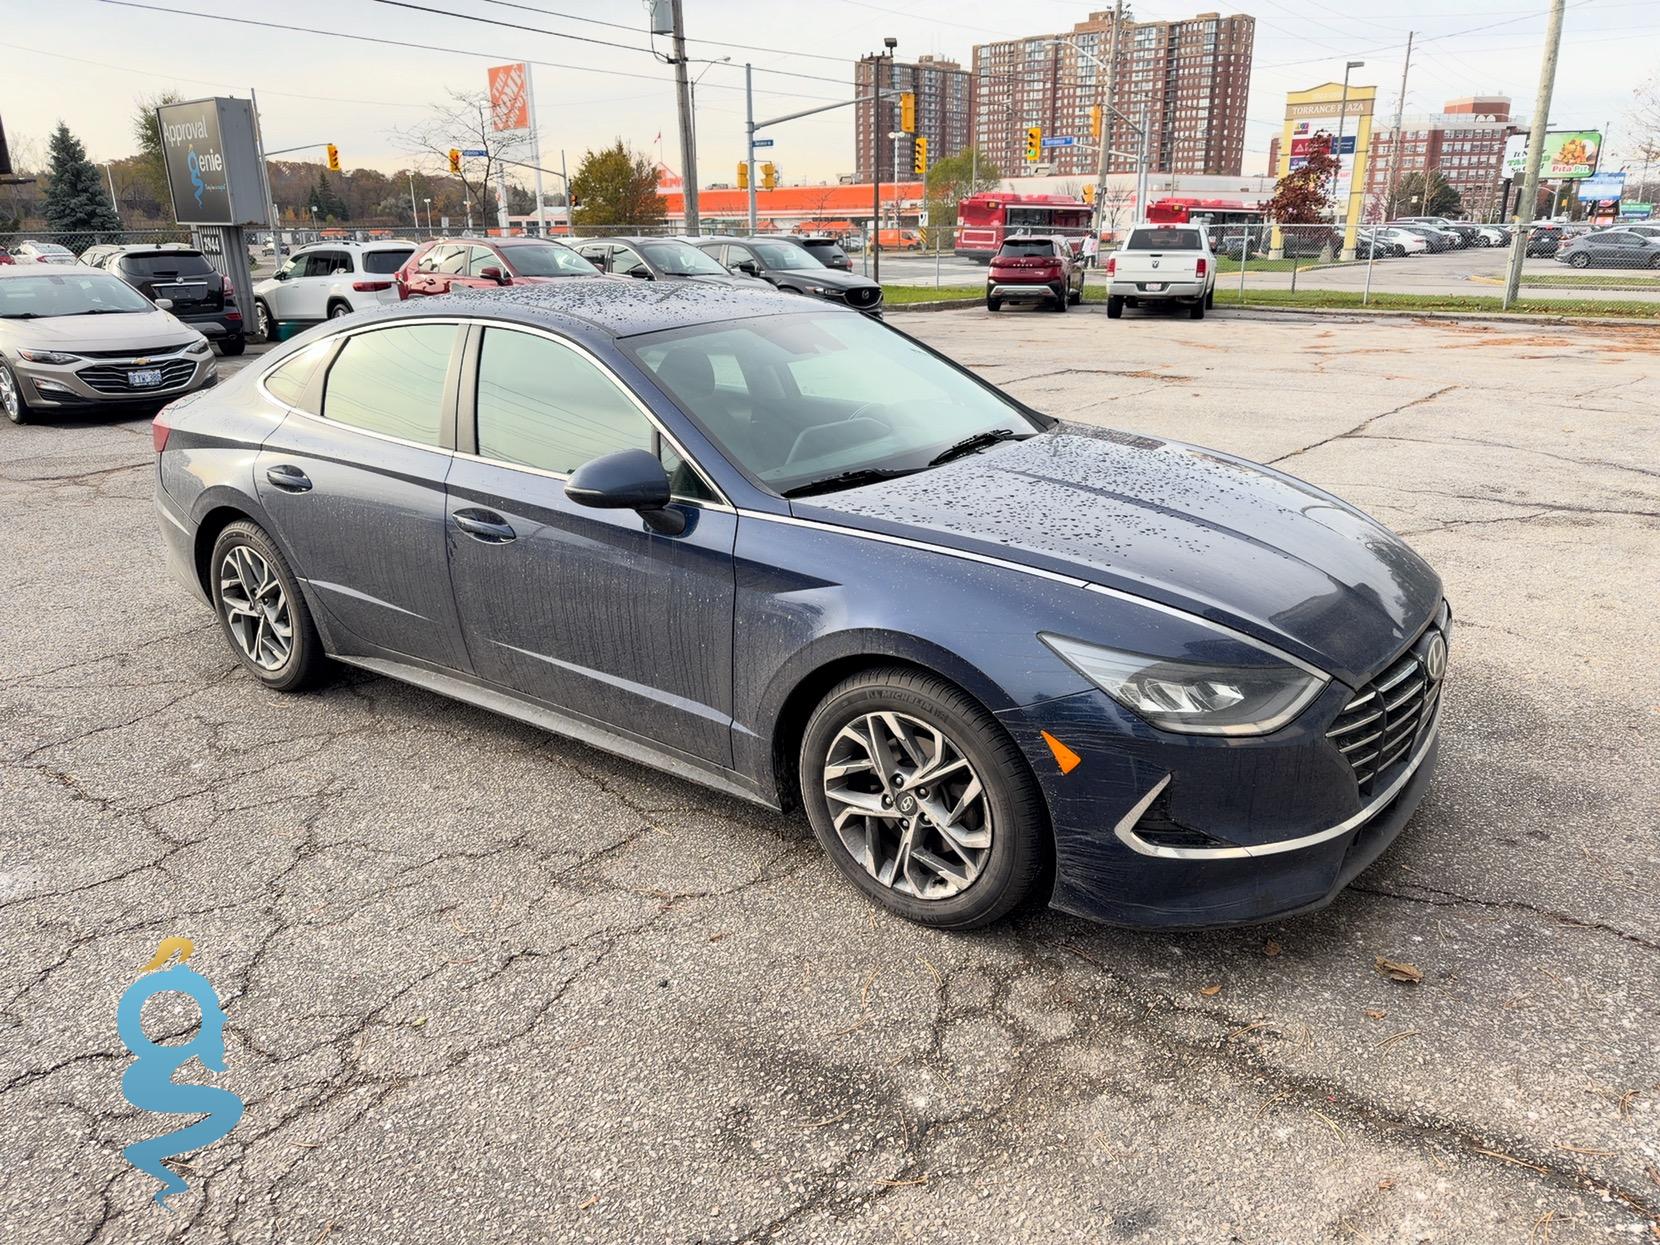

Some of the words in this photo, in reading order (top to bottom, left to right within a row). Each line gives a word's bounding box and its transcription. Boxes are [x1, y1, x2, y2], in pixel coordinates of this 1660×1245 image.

[492, 69, 507, 98] THE
[494, 65, 523, 130] HOME
[1293, 104, 1337, 115] TORRANCE
[163, 116, 208, 146] Approval
[1552, 165, 1573, 173] Pita
[881, 690, 934, 713] MICHELIN
